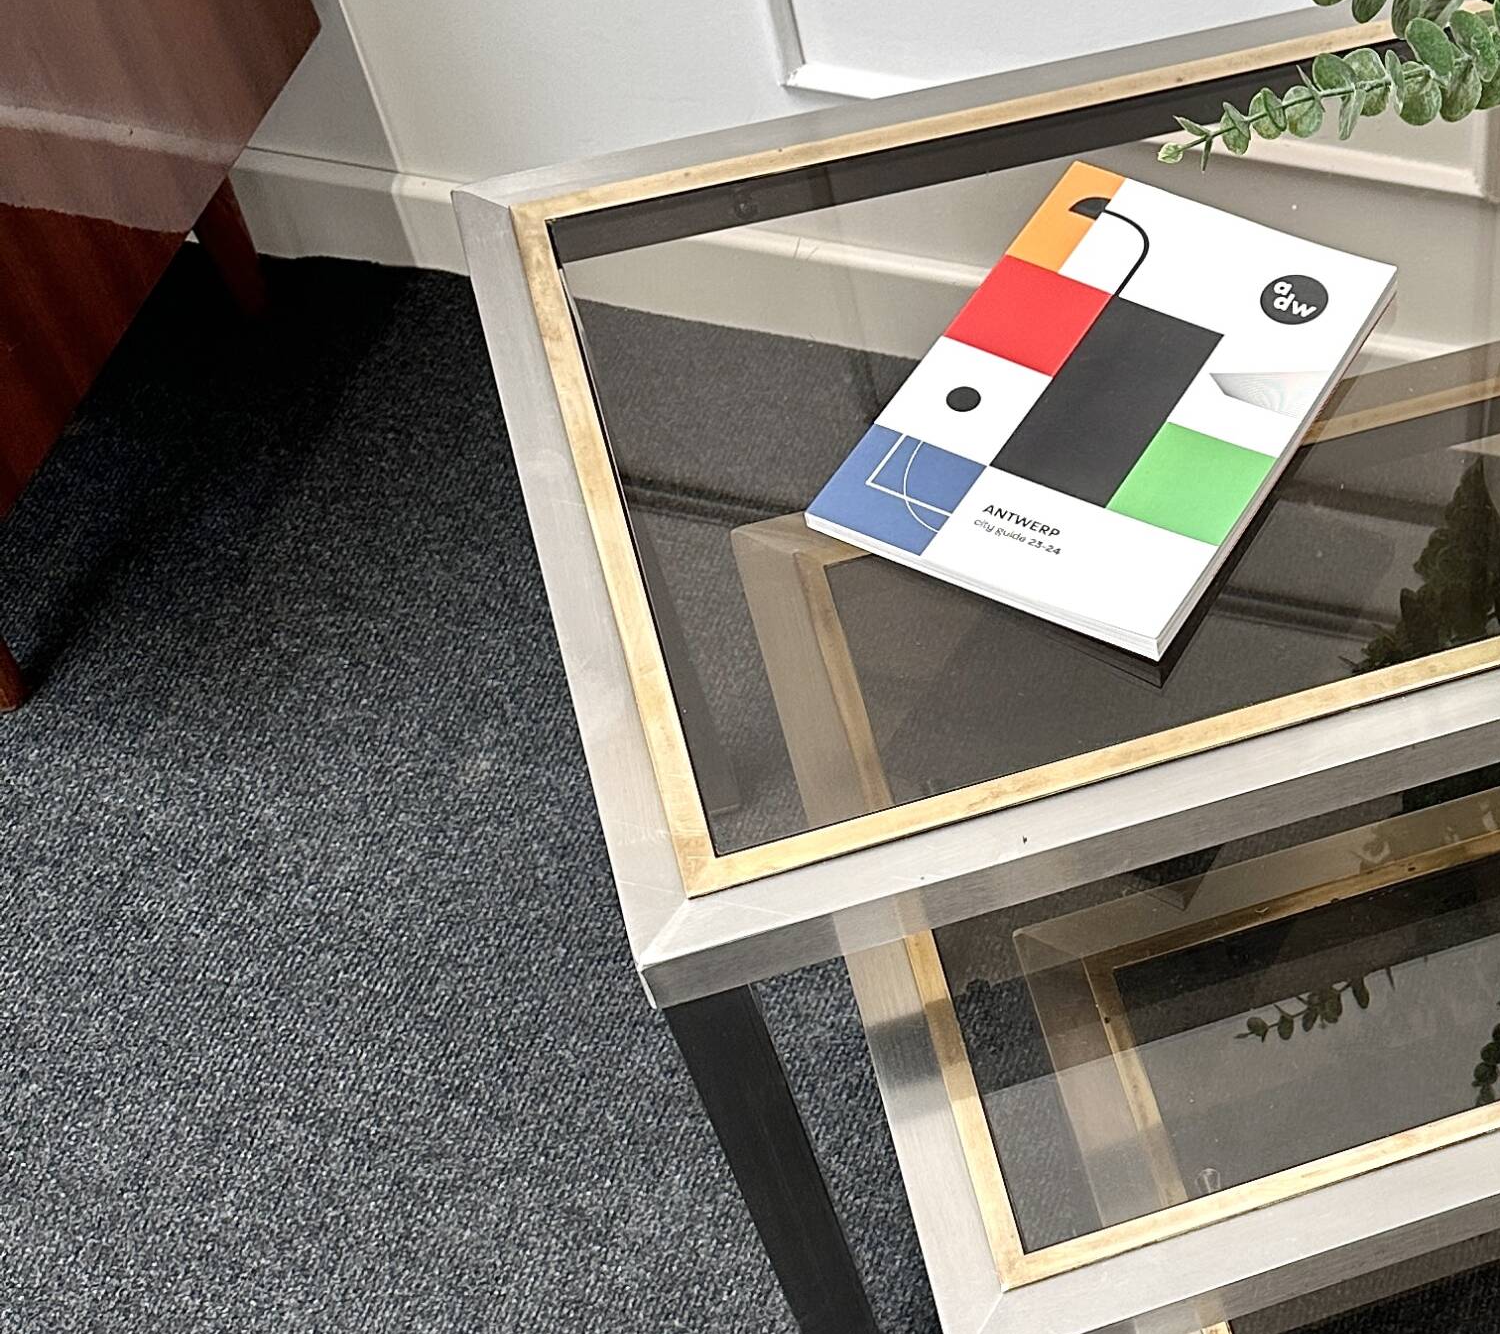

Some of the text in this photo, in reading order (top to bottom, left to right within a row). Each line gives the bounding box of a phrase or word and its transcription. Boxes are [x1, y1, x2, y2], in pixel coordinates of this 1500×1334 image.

[974, 519, 1062, 555] city guide 23-24
[982, 504, 1061, 537] ANTWERP
